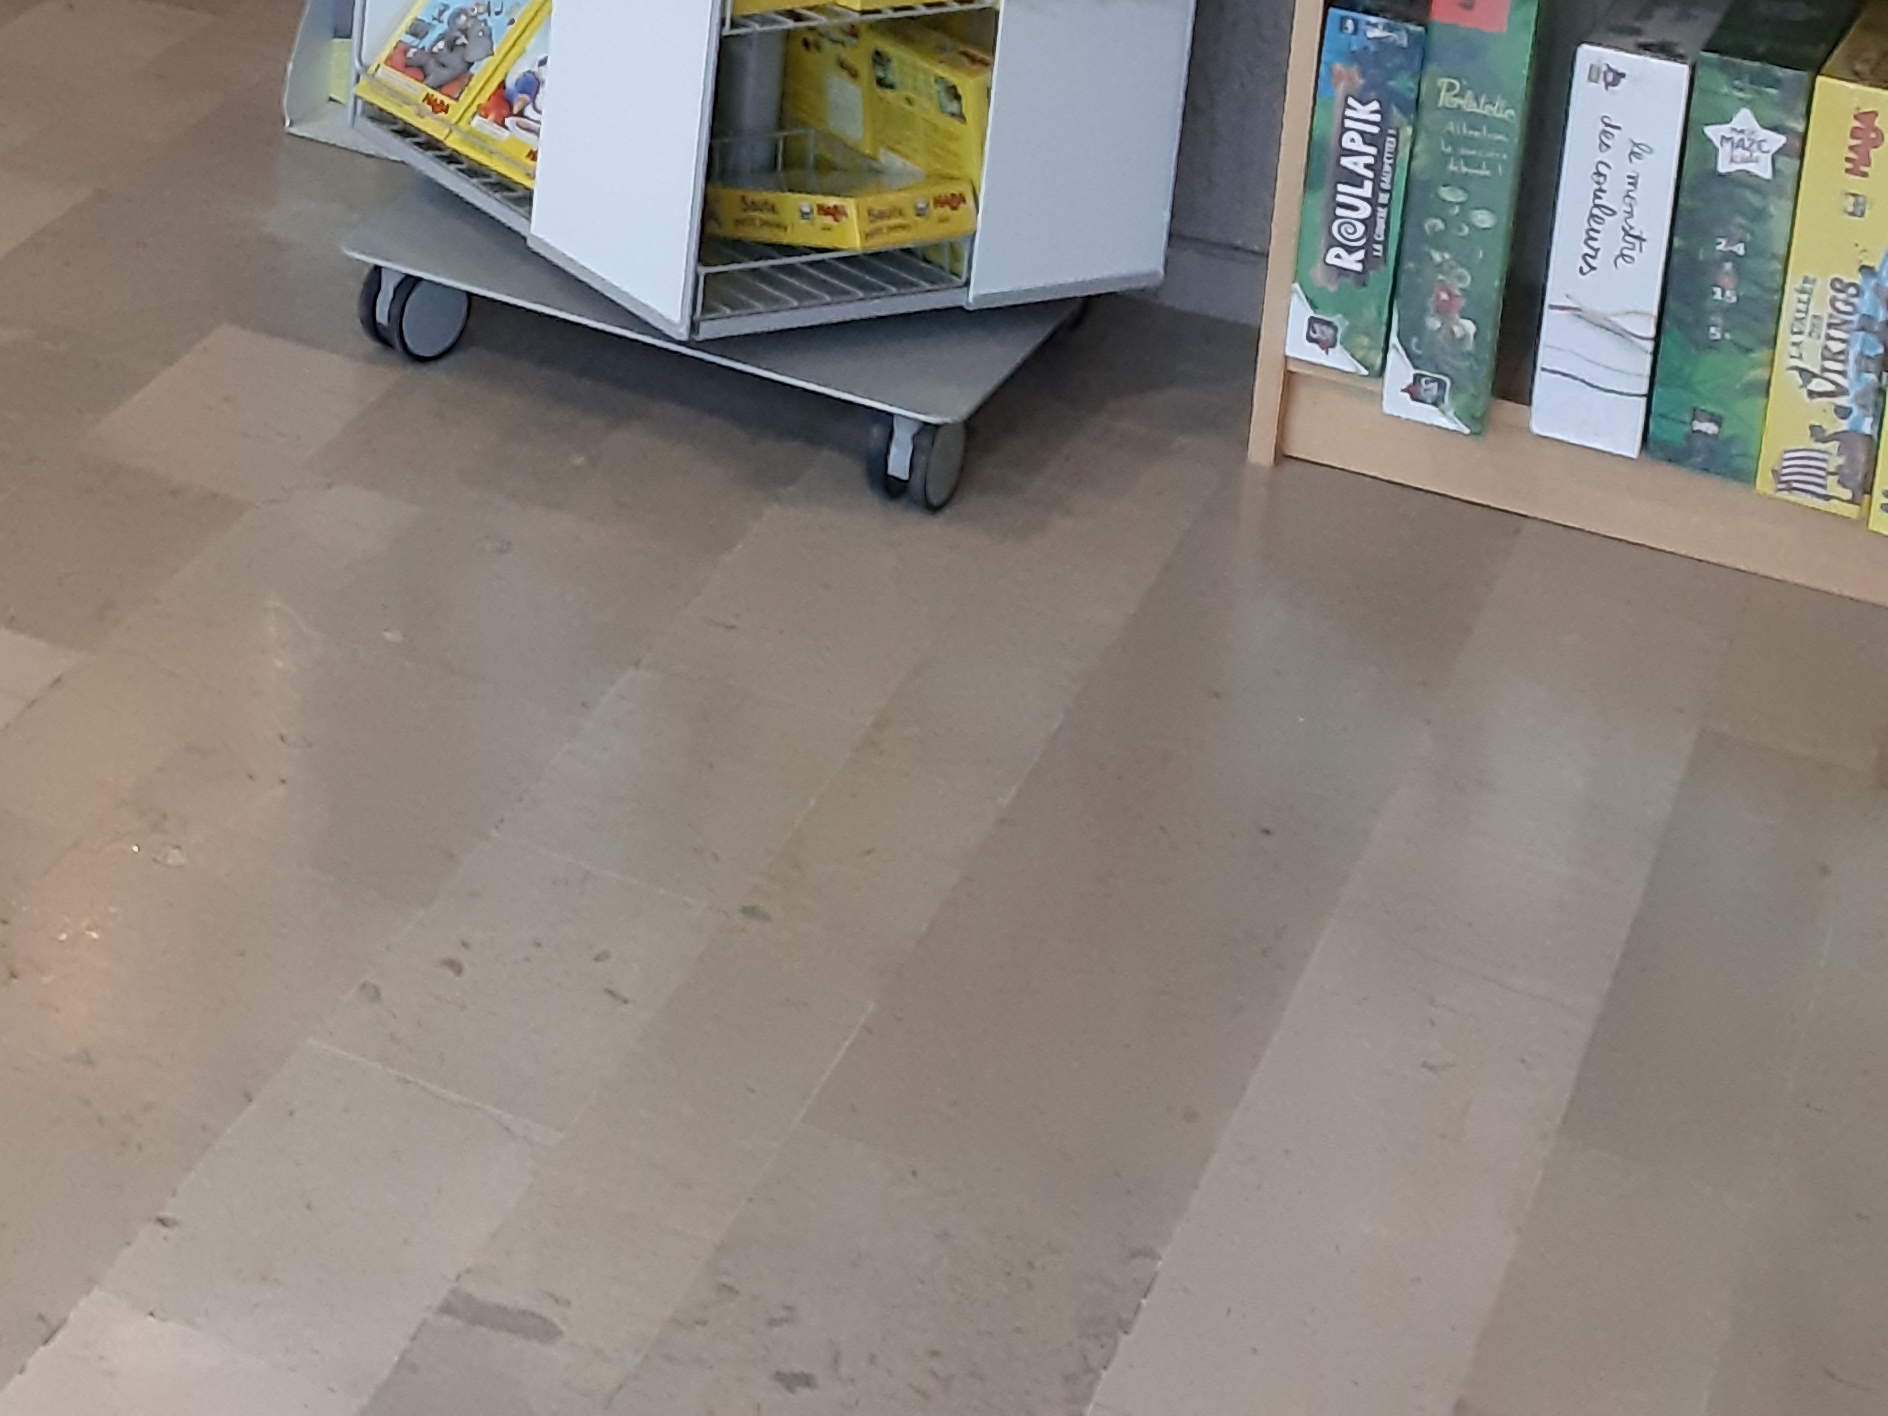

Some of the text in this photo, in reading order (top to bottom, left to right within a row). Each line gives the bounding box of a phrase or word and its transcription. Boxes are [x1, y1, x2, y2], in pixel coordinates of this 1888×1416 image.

[1324, 94, 1382, 273] ROULAPIK
[1577, 113, 1624, 278] des couleurs
[1613, 137, 1655, 270] le monstre
[1844, 108, 1886, 180] HABA
[1805, 275, 1863, 408] VIKINGS
